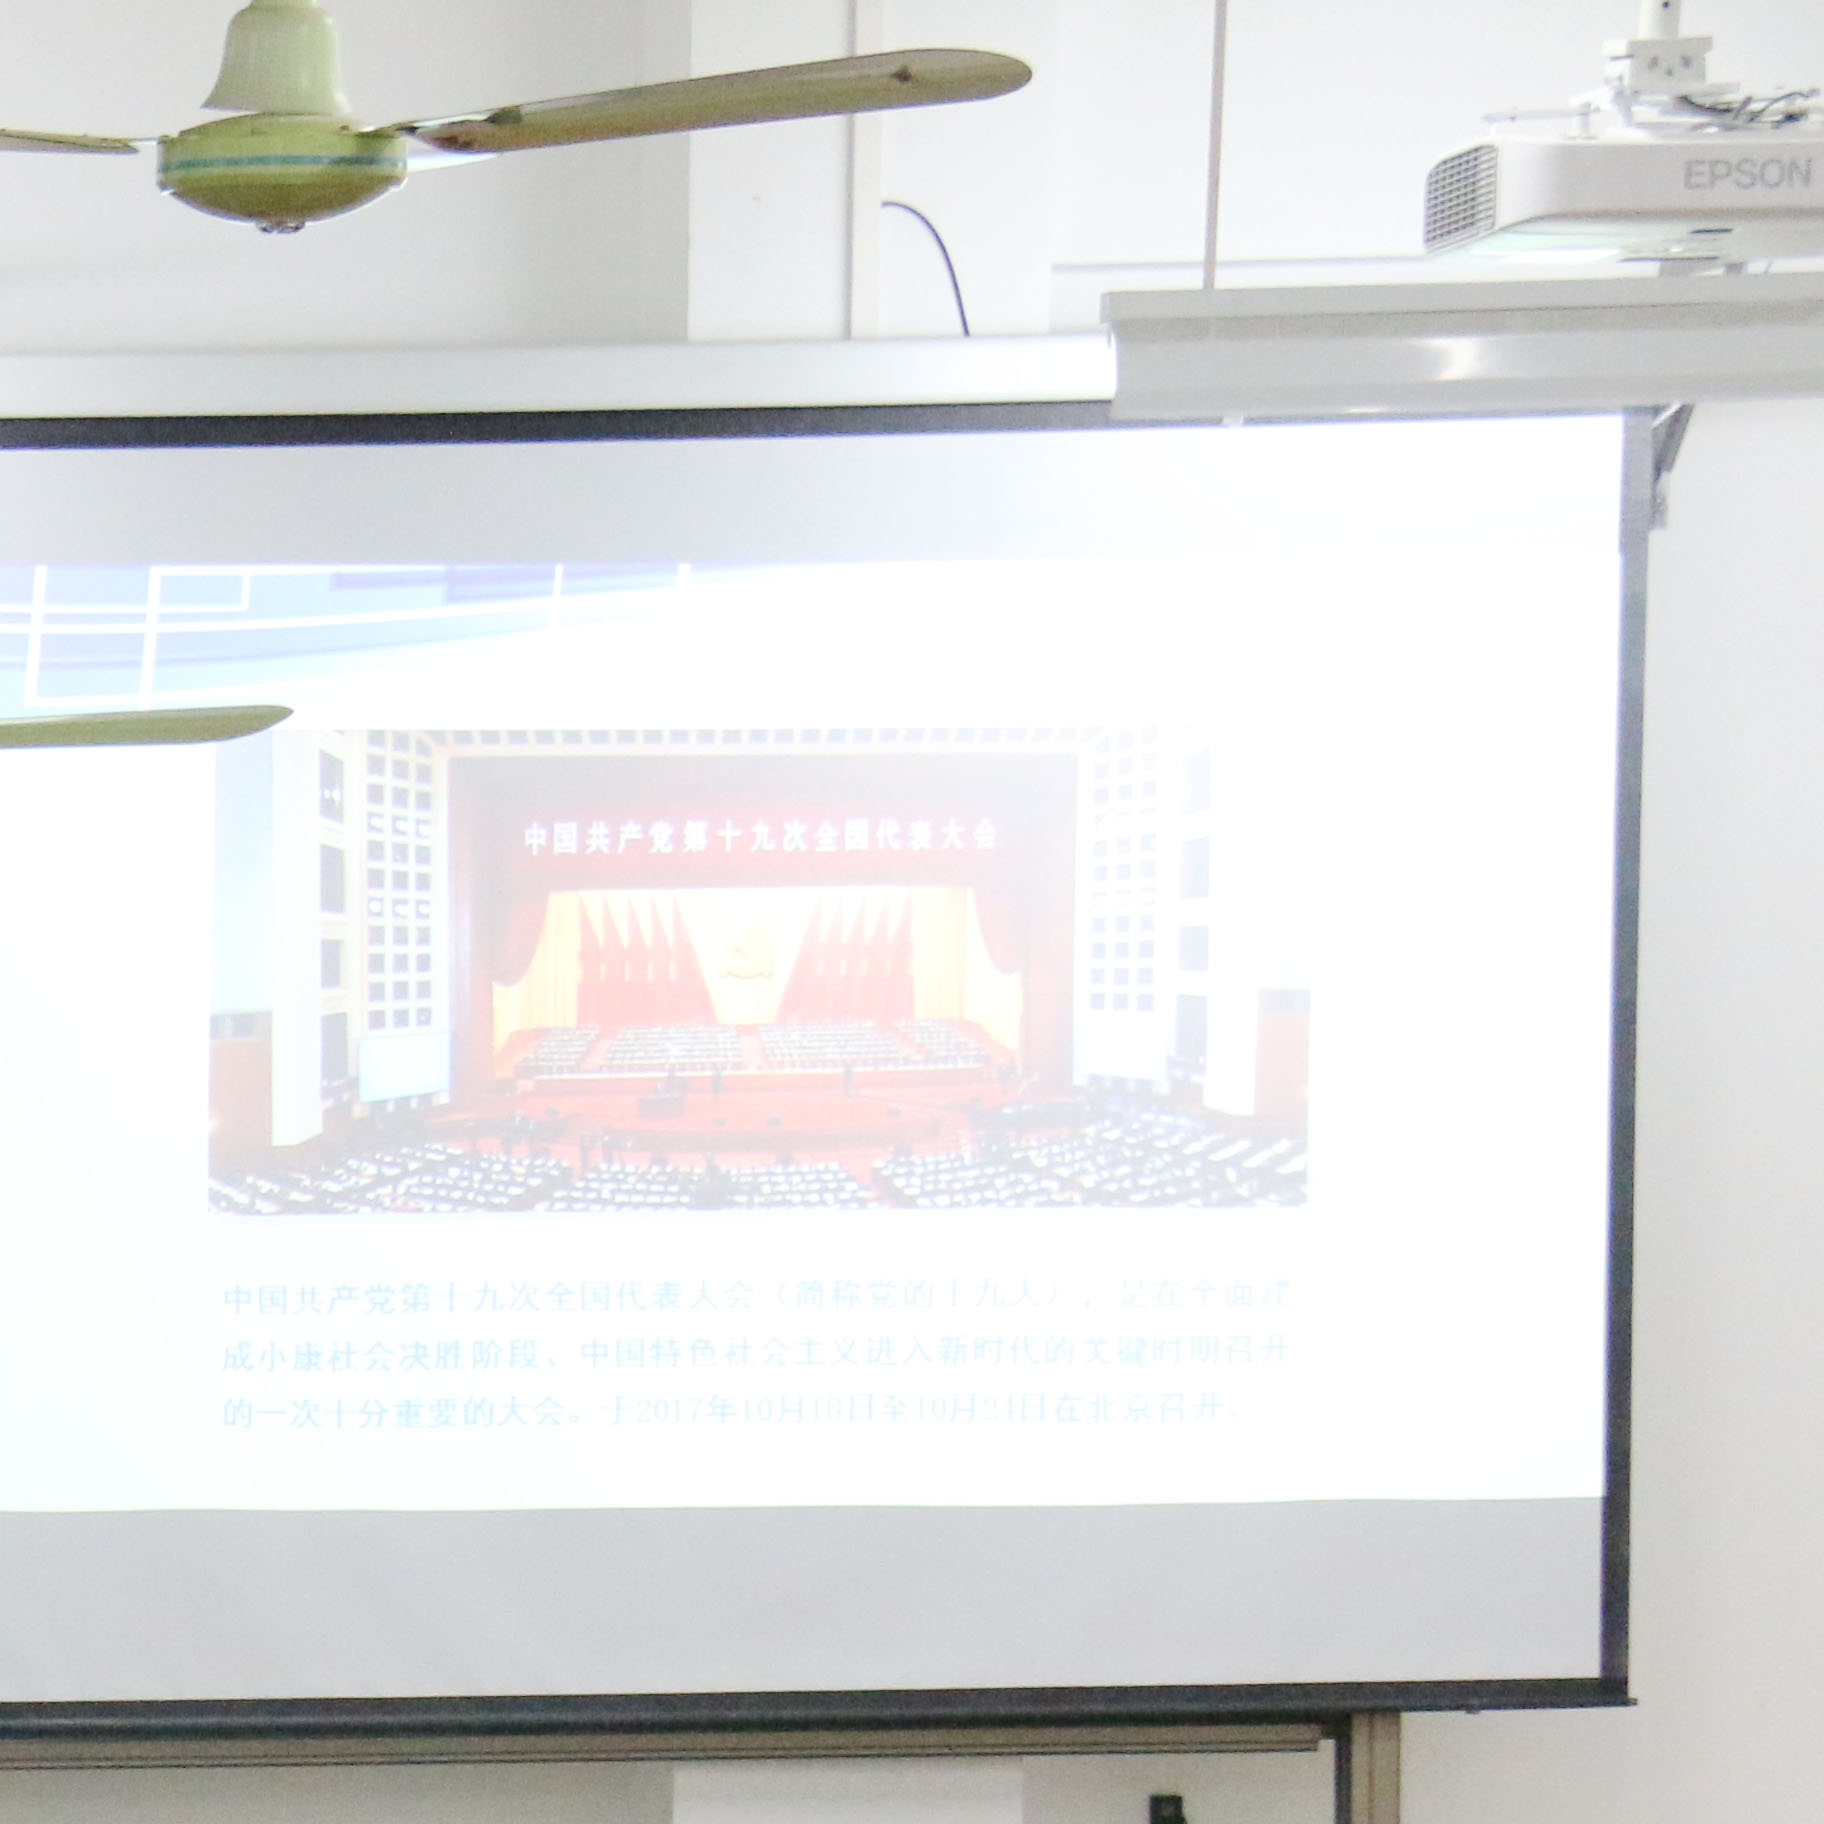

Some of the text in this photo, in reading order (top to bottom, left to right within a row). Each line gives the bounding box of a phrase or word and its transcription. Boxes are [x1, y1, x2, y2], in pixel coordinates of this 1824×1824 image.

[1684, 158, 1813, 191] EPSON
[524, 818, 999, 855] 中国共产党第十九次全国代表大会
